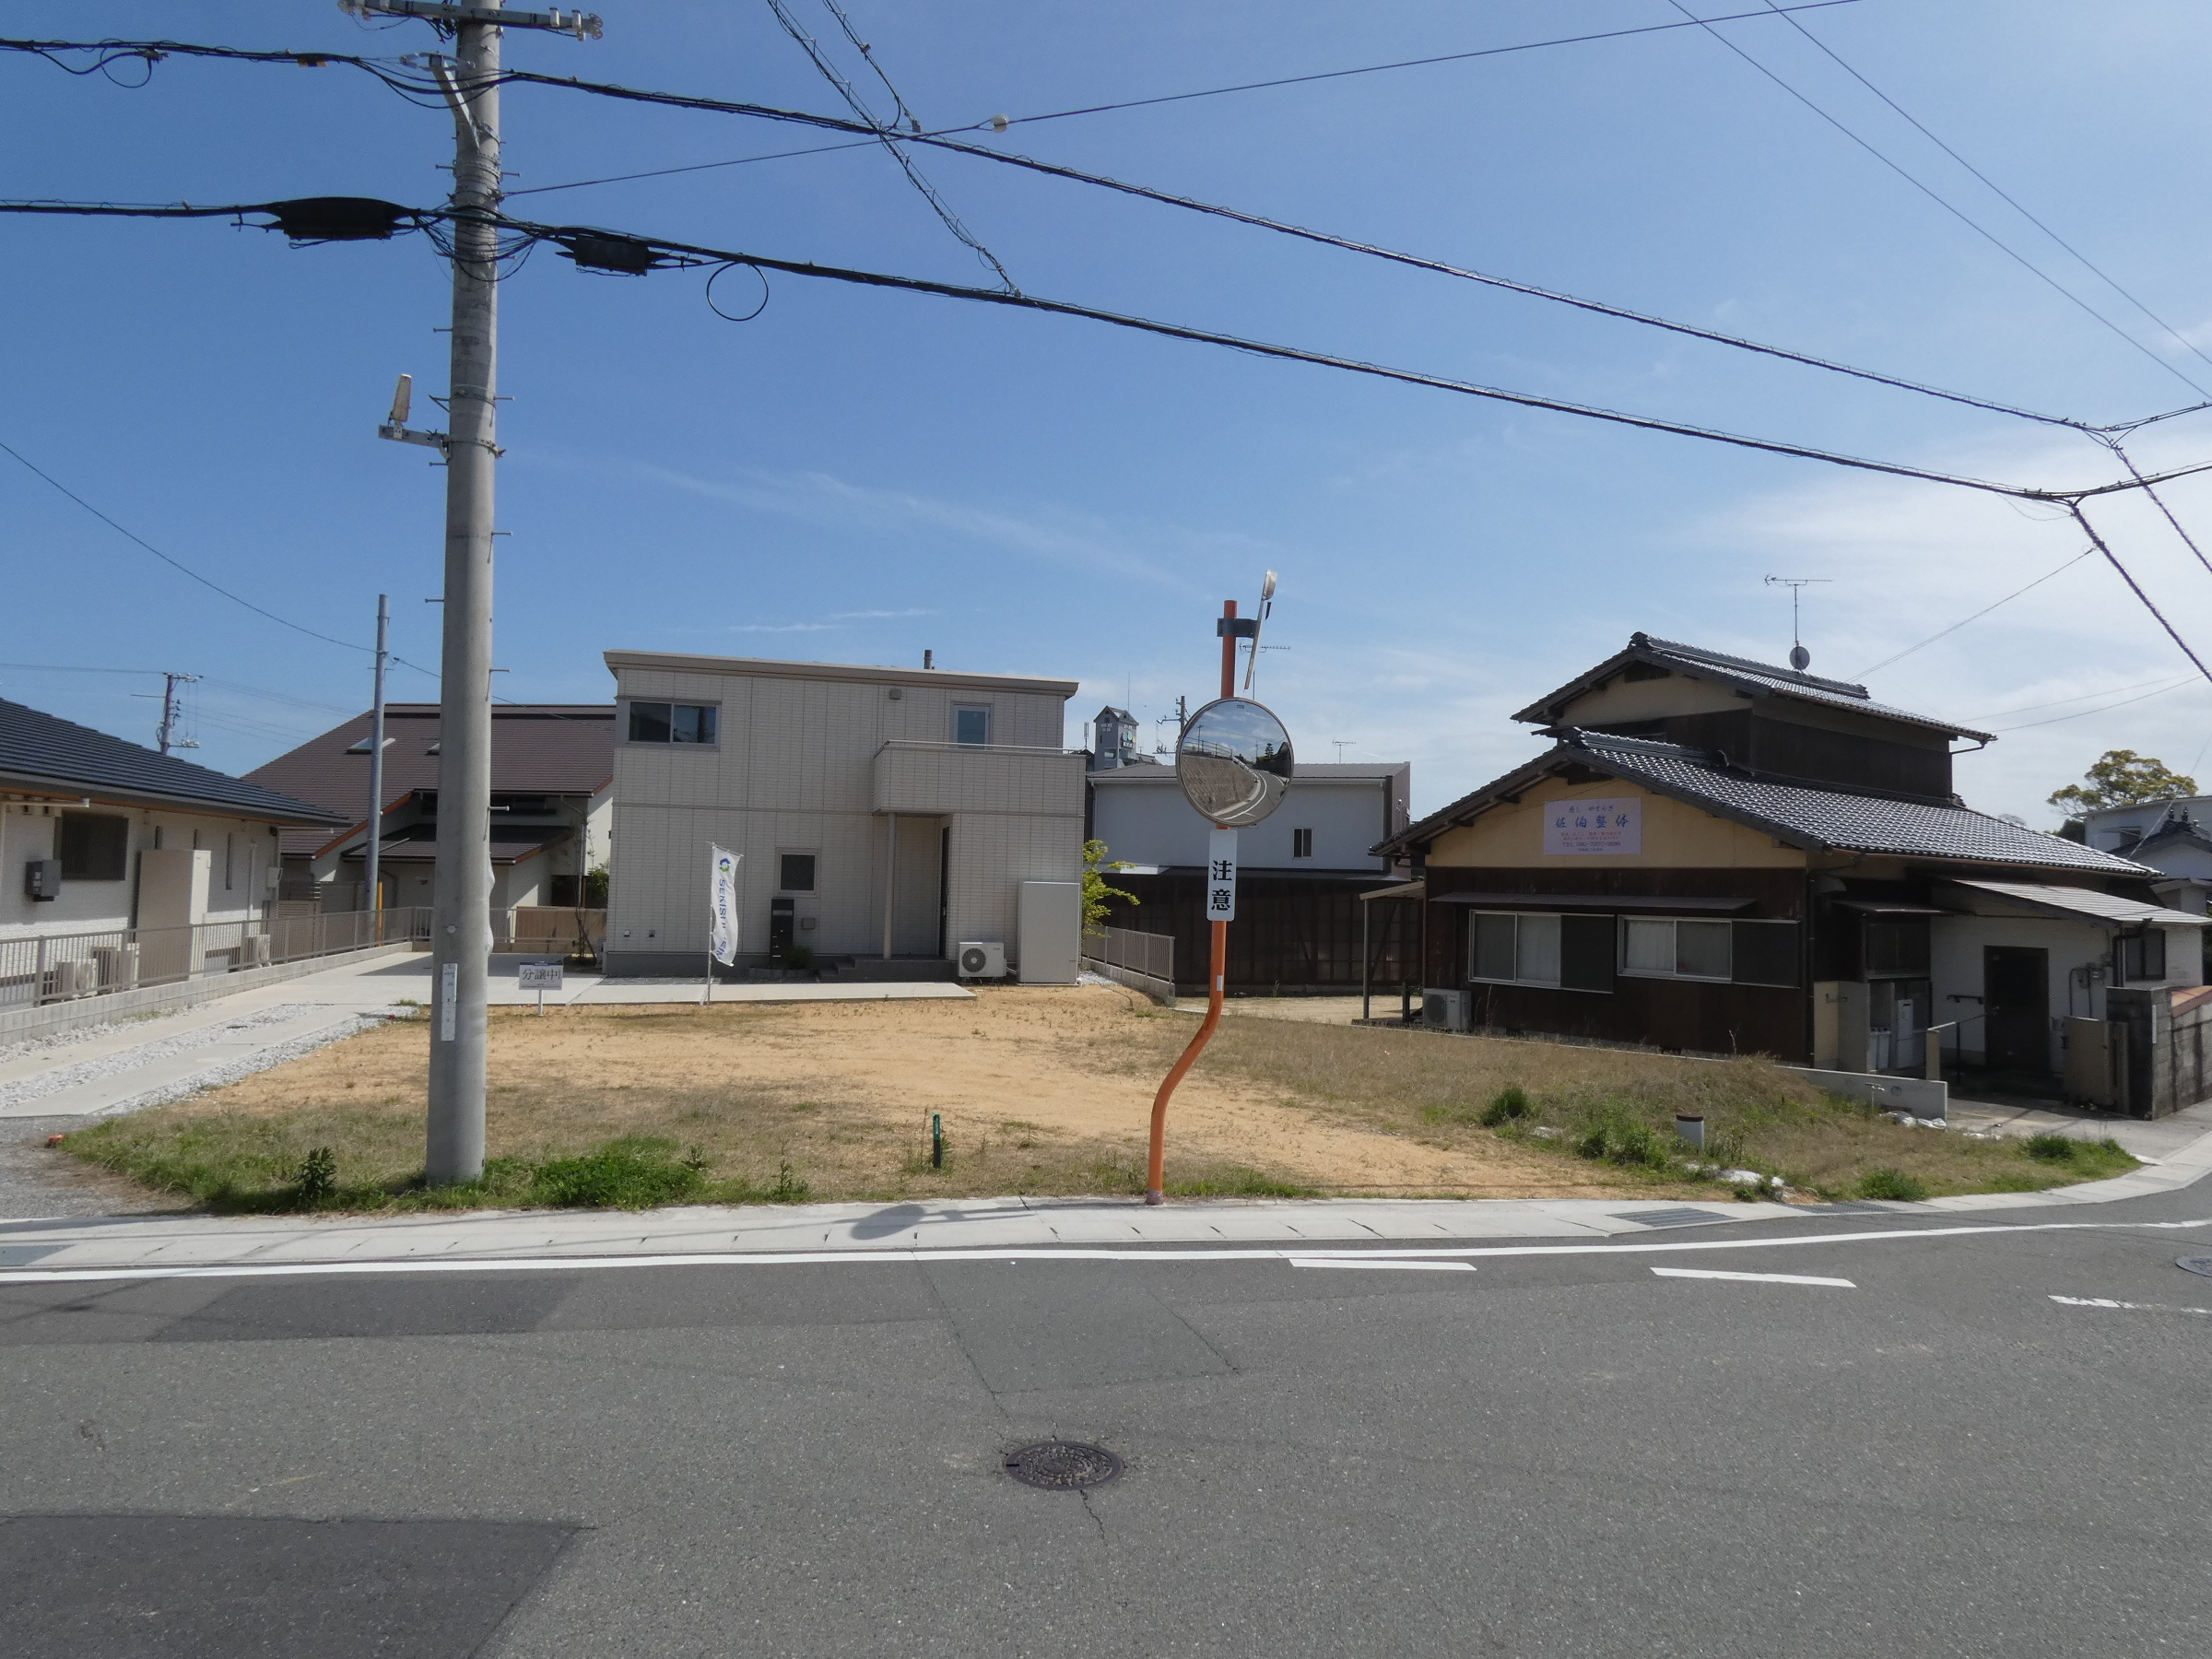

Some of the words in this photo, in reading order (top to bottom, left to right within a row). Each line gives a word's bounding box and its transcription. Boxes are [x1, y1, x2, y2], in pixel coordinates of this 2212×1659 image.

[1211, 860, 1232, 911] 注意
[523, 969, 558, 980] 分譲中
